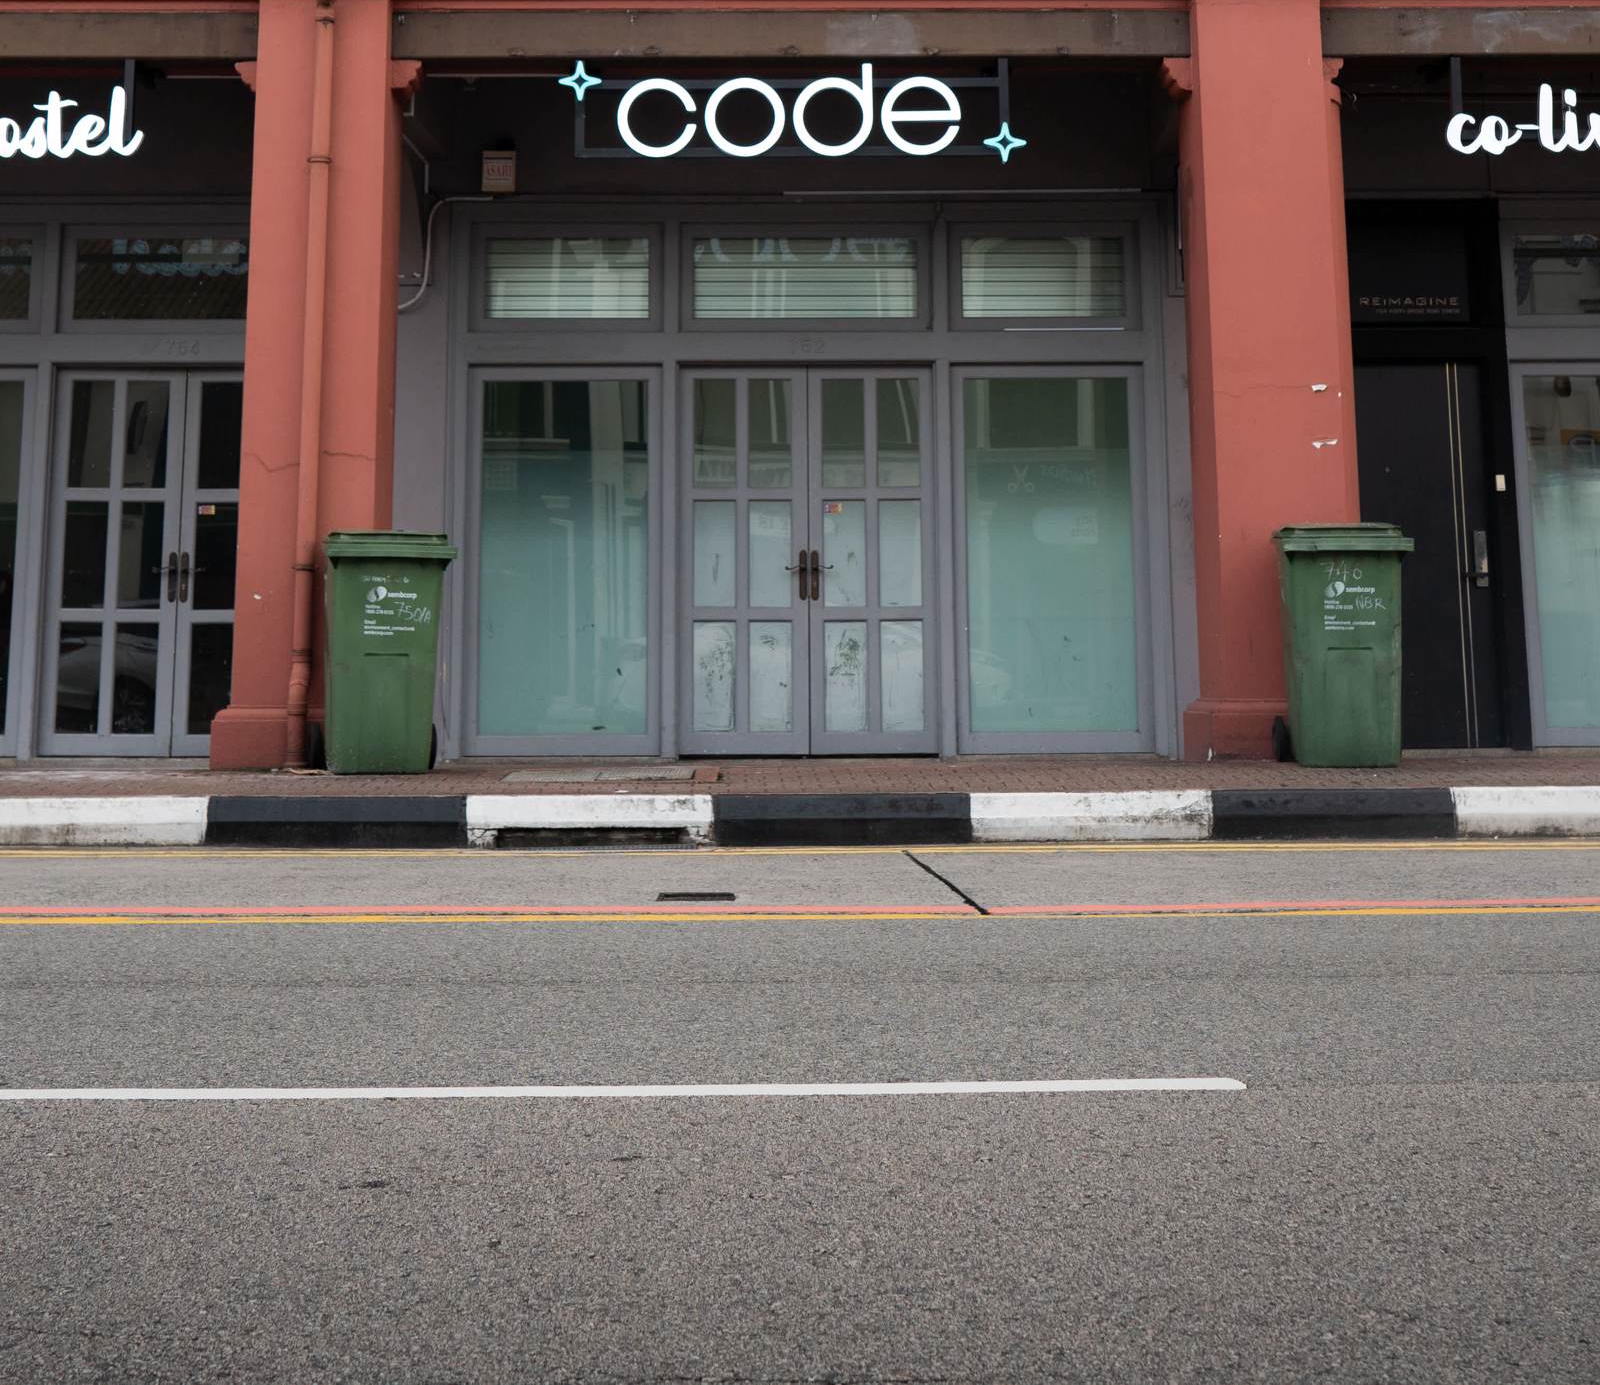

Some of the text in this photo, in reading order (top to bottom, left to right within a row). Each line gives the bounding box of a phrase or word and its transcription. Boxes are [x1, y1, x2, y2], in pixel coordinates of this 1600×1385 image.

[0, 85, 144, 159] ostel
[617, 63, 962, 157] code
[1359, 296, 1459, 307] REIMAGINE
[1345, 586, 1375, 594] sembcorp
